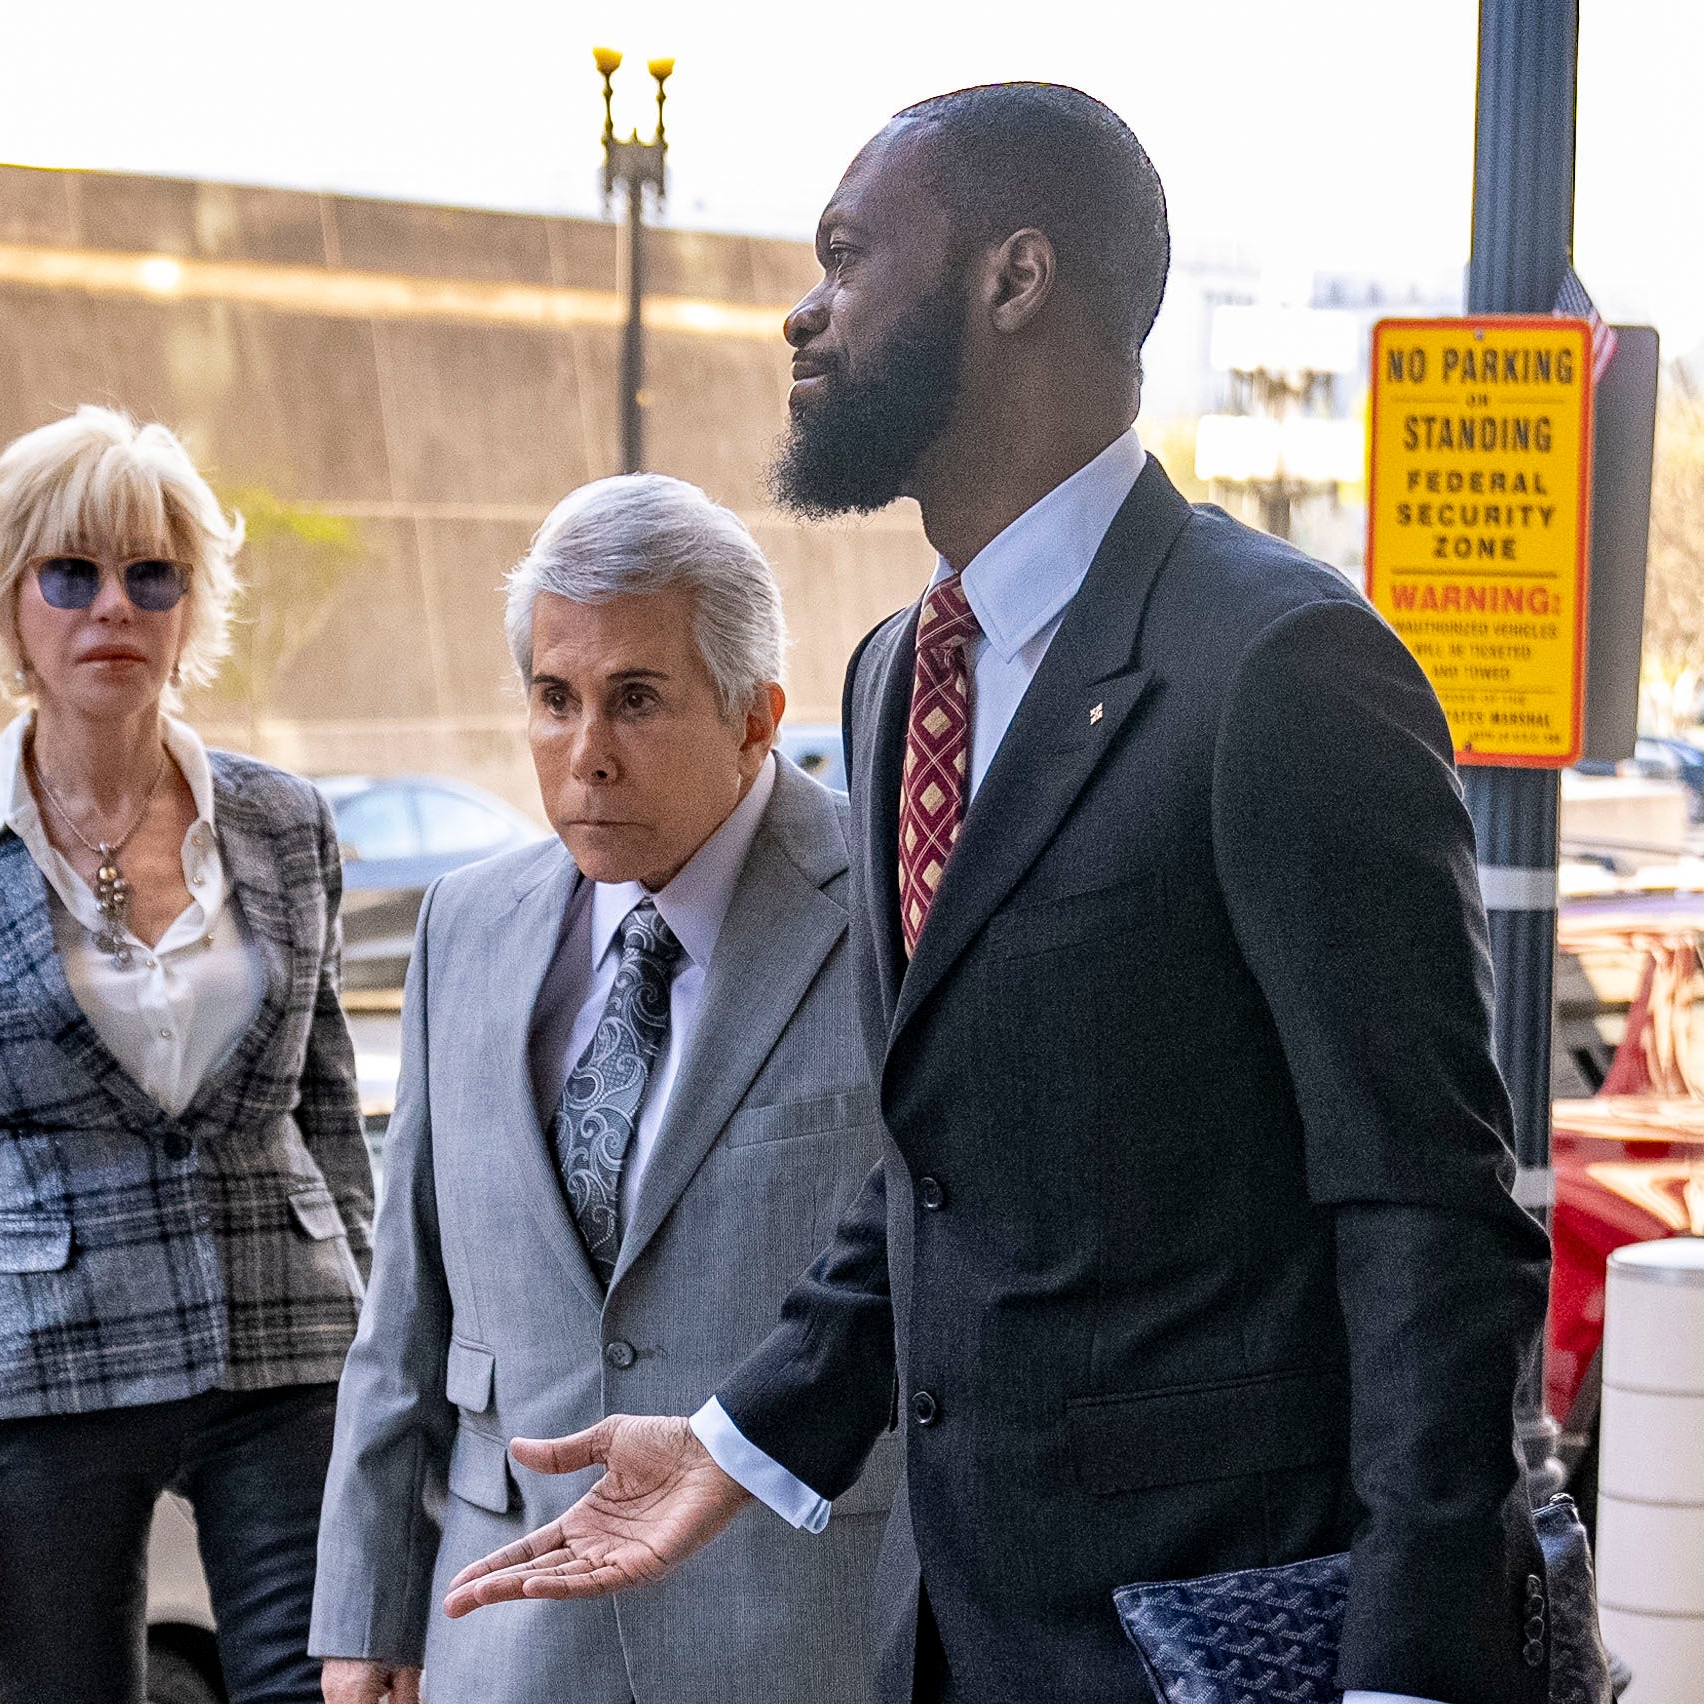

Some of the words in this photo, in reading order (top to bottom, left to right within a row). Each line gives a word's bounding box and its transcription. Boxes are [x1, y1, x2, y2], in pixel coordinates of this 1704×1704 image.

[1388, 347, 1426, 384] NO
[1442, 348, 1574, 385] PARKING
[1403, 414, 1552, 453] STANDING
[1407, 469, 1548, 495] FEDERAL
[1397, 503, 1557, 528] SECURITY
[1432, 534, 1517, 561] ZONE
[1392, 583, 1561, 616] WARNING:
